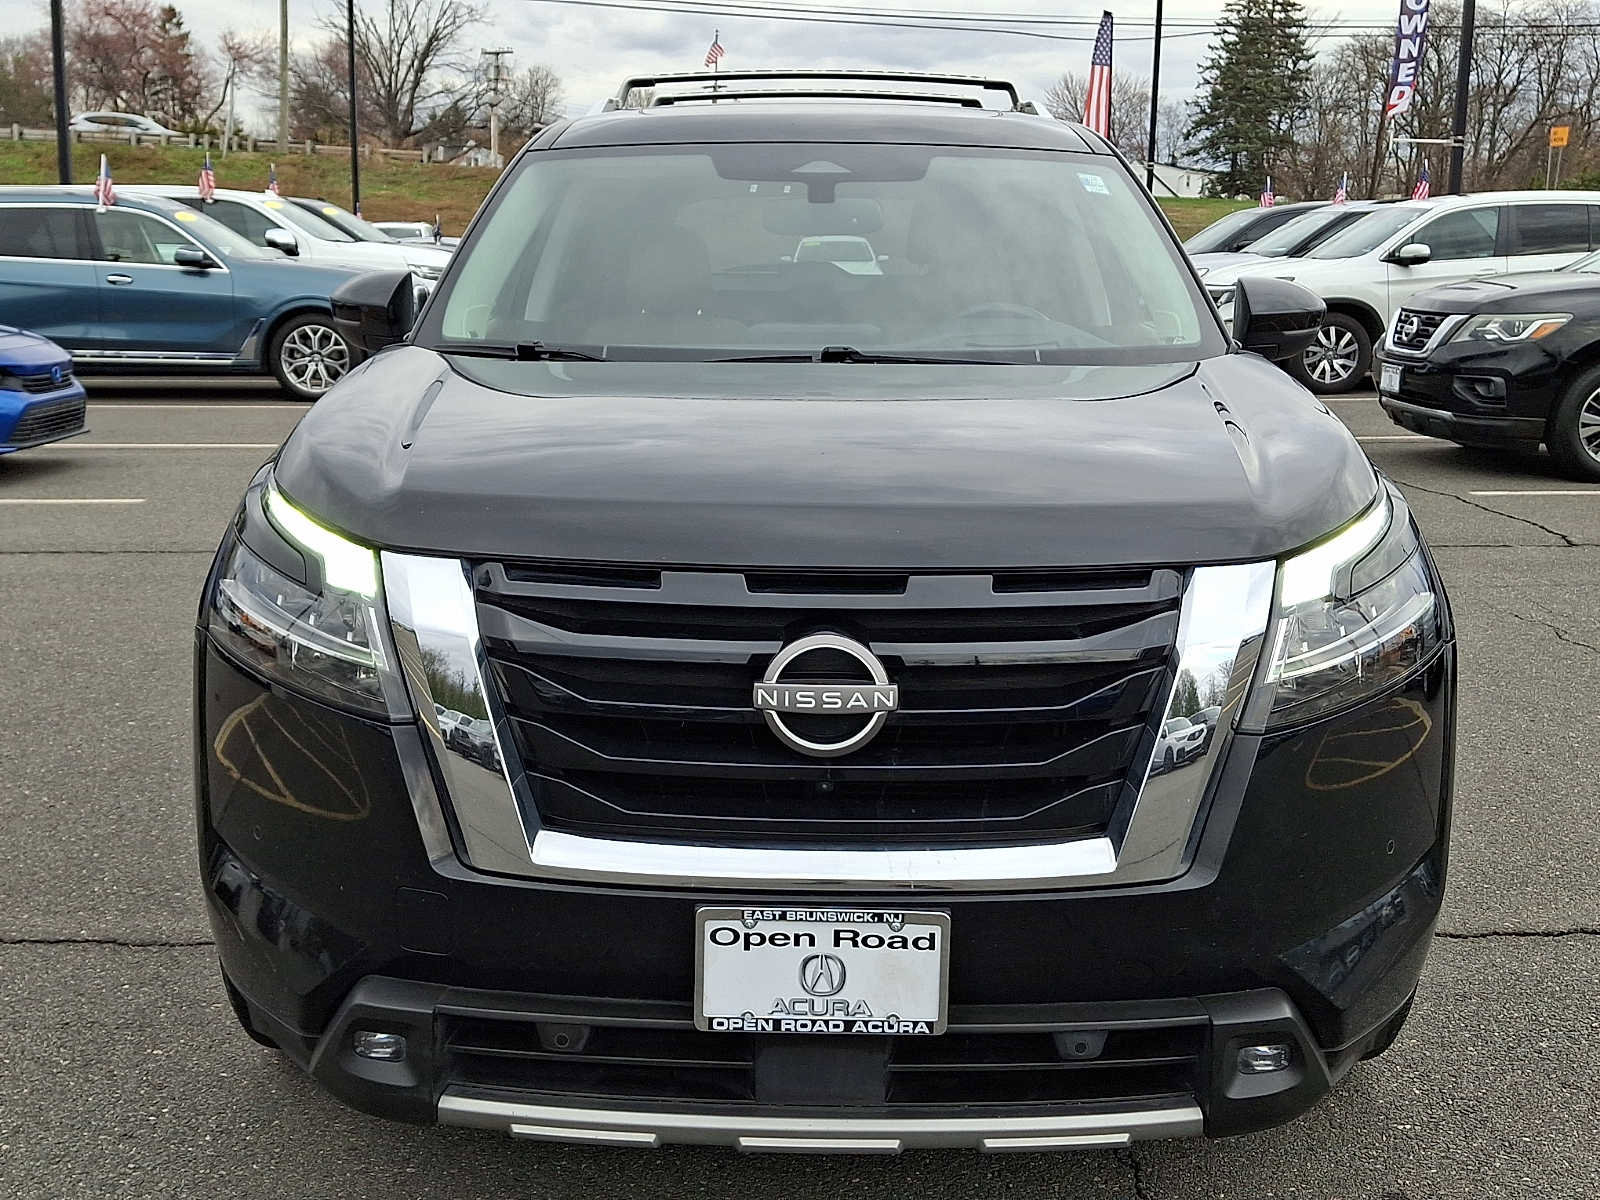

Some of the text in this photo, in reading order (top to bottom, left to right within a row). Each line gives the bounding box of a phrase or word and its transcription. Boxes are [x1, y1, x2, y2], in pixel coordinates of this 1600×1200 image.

[757, 688, 894, 708] NISSAN
[743, 910, 903, 922] EAST BRUNSWICK, NJ
[709, 926, 936, 952] Open Road
[768, 998, 873, 1017] ACURA
[712, 1018, 930, 1034] OPEN ROAD ACURA
